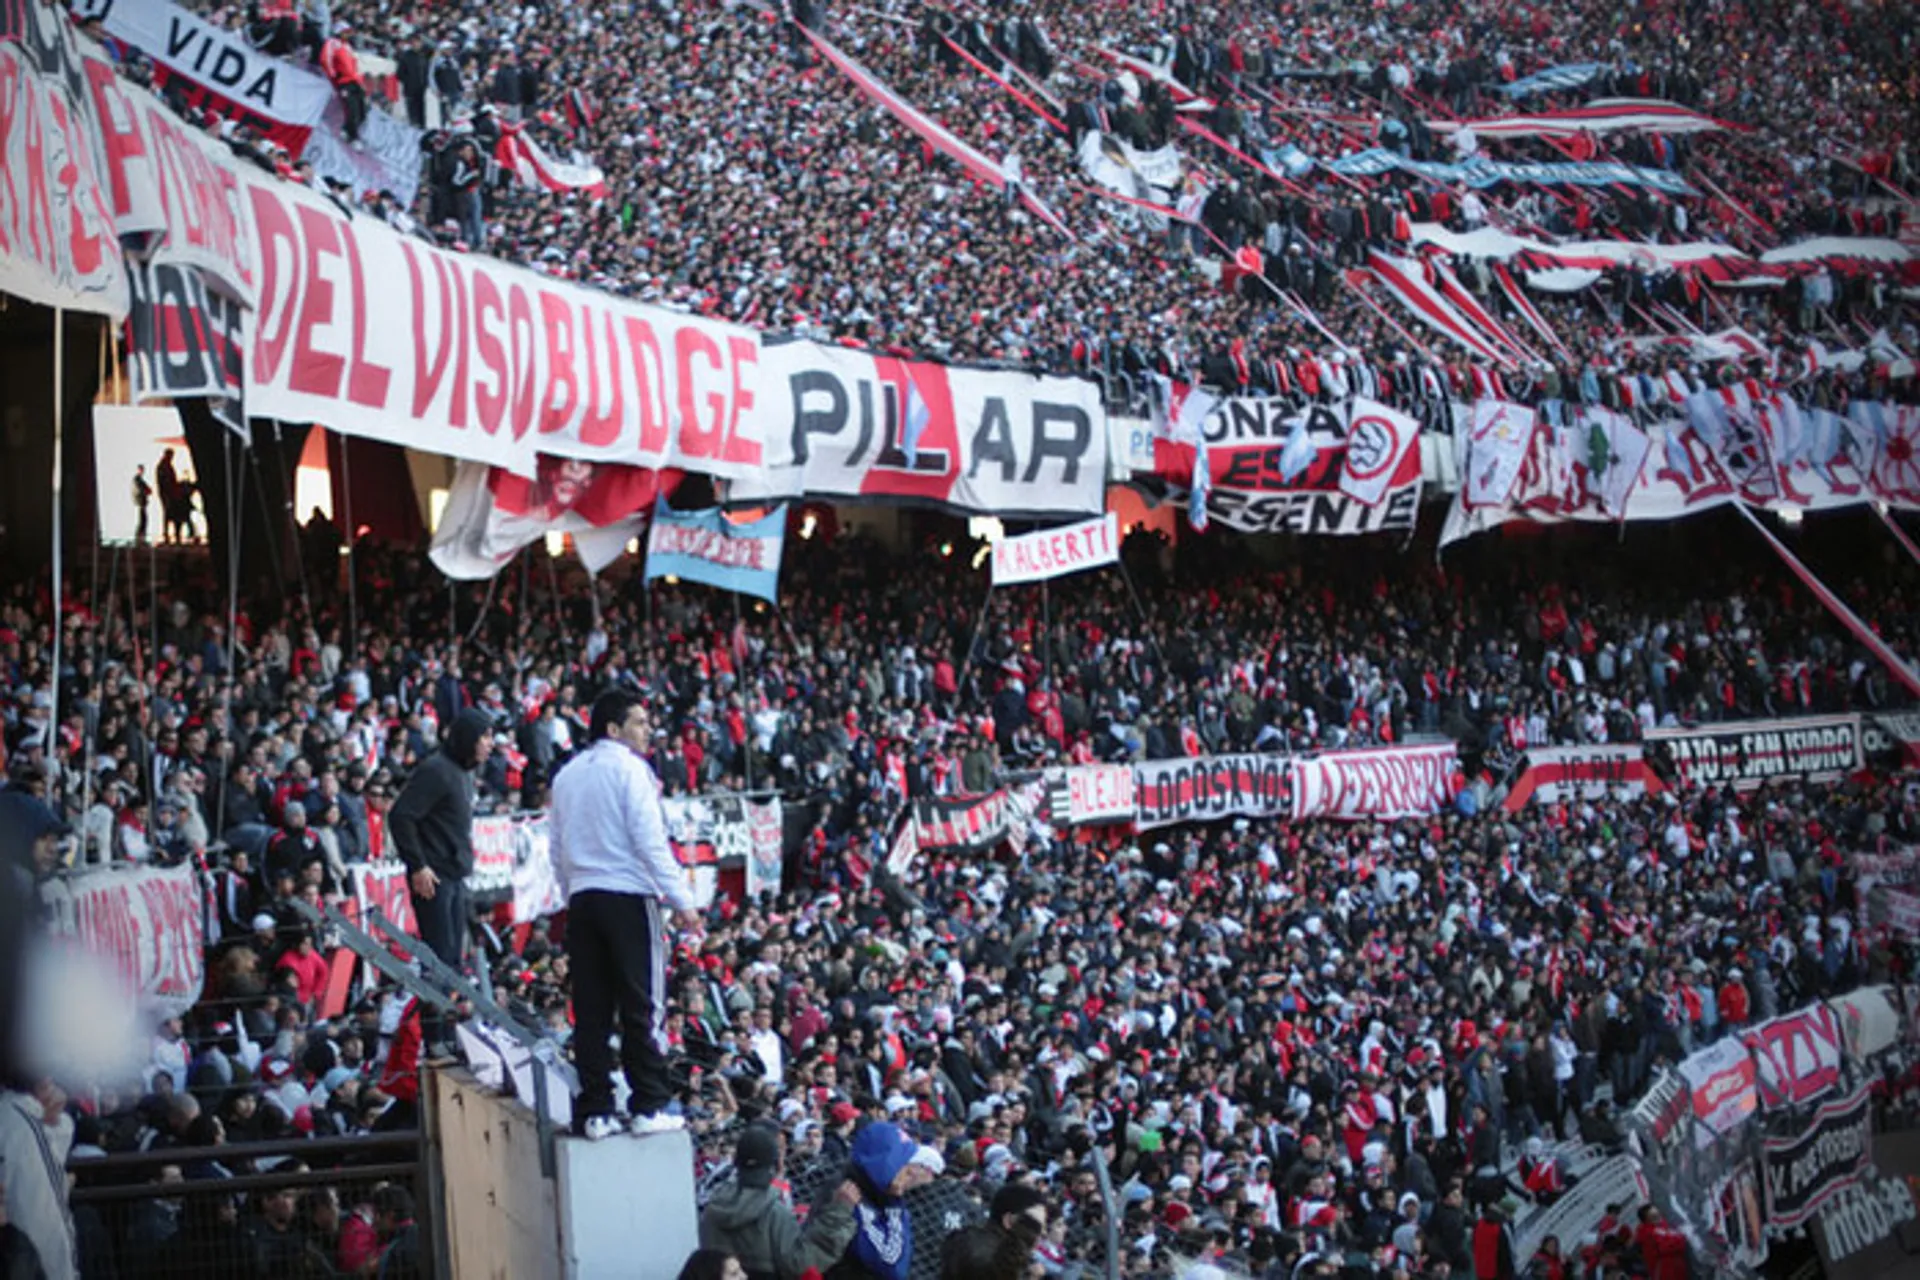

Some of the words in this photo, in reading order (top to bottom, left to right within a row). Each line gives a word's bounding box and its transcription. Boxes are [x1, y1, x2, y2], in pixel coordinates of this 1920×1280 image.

[167, 16, 276, 107] VIDA
[248, 184, 391, 409] DEL
[403, 240, 535, 442] VISO
[538, 290, 763, 465] BUDGE
[789, 370, 1091, 484] PILAR
[1205, 400, 1345, 442] ONZA
[1742, 730, 1784, 775] SAN
[1785, 725, 1852, 770] ISIDRO
